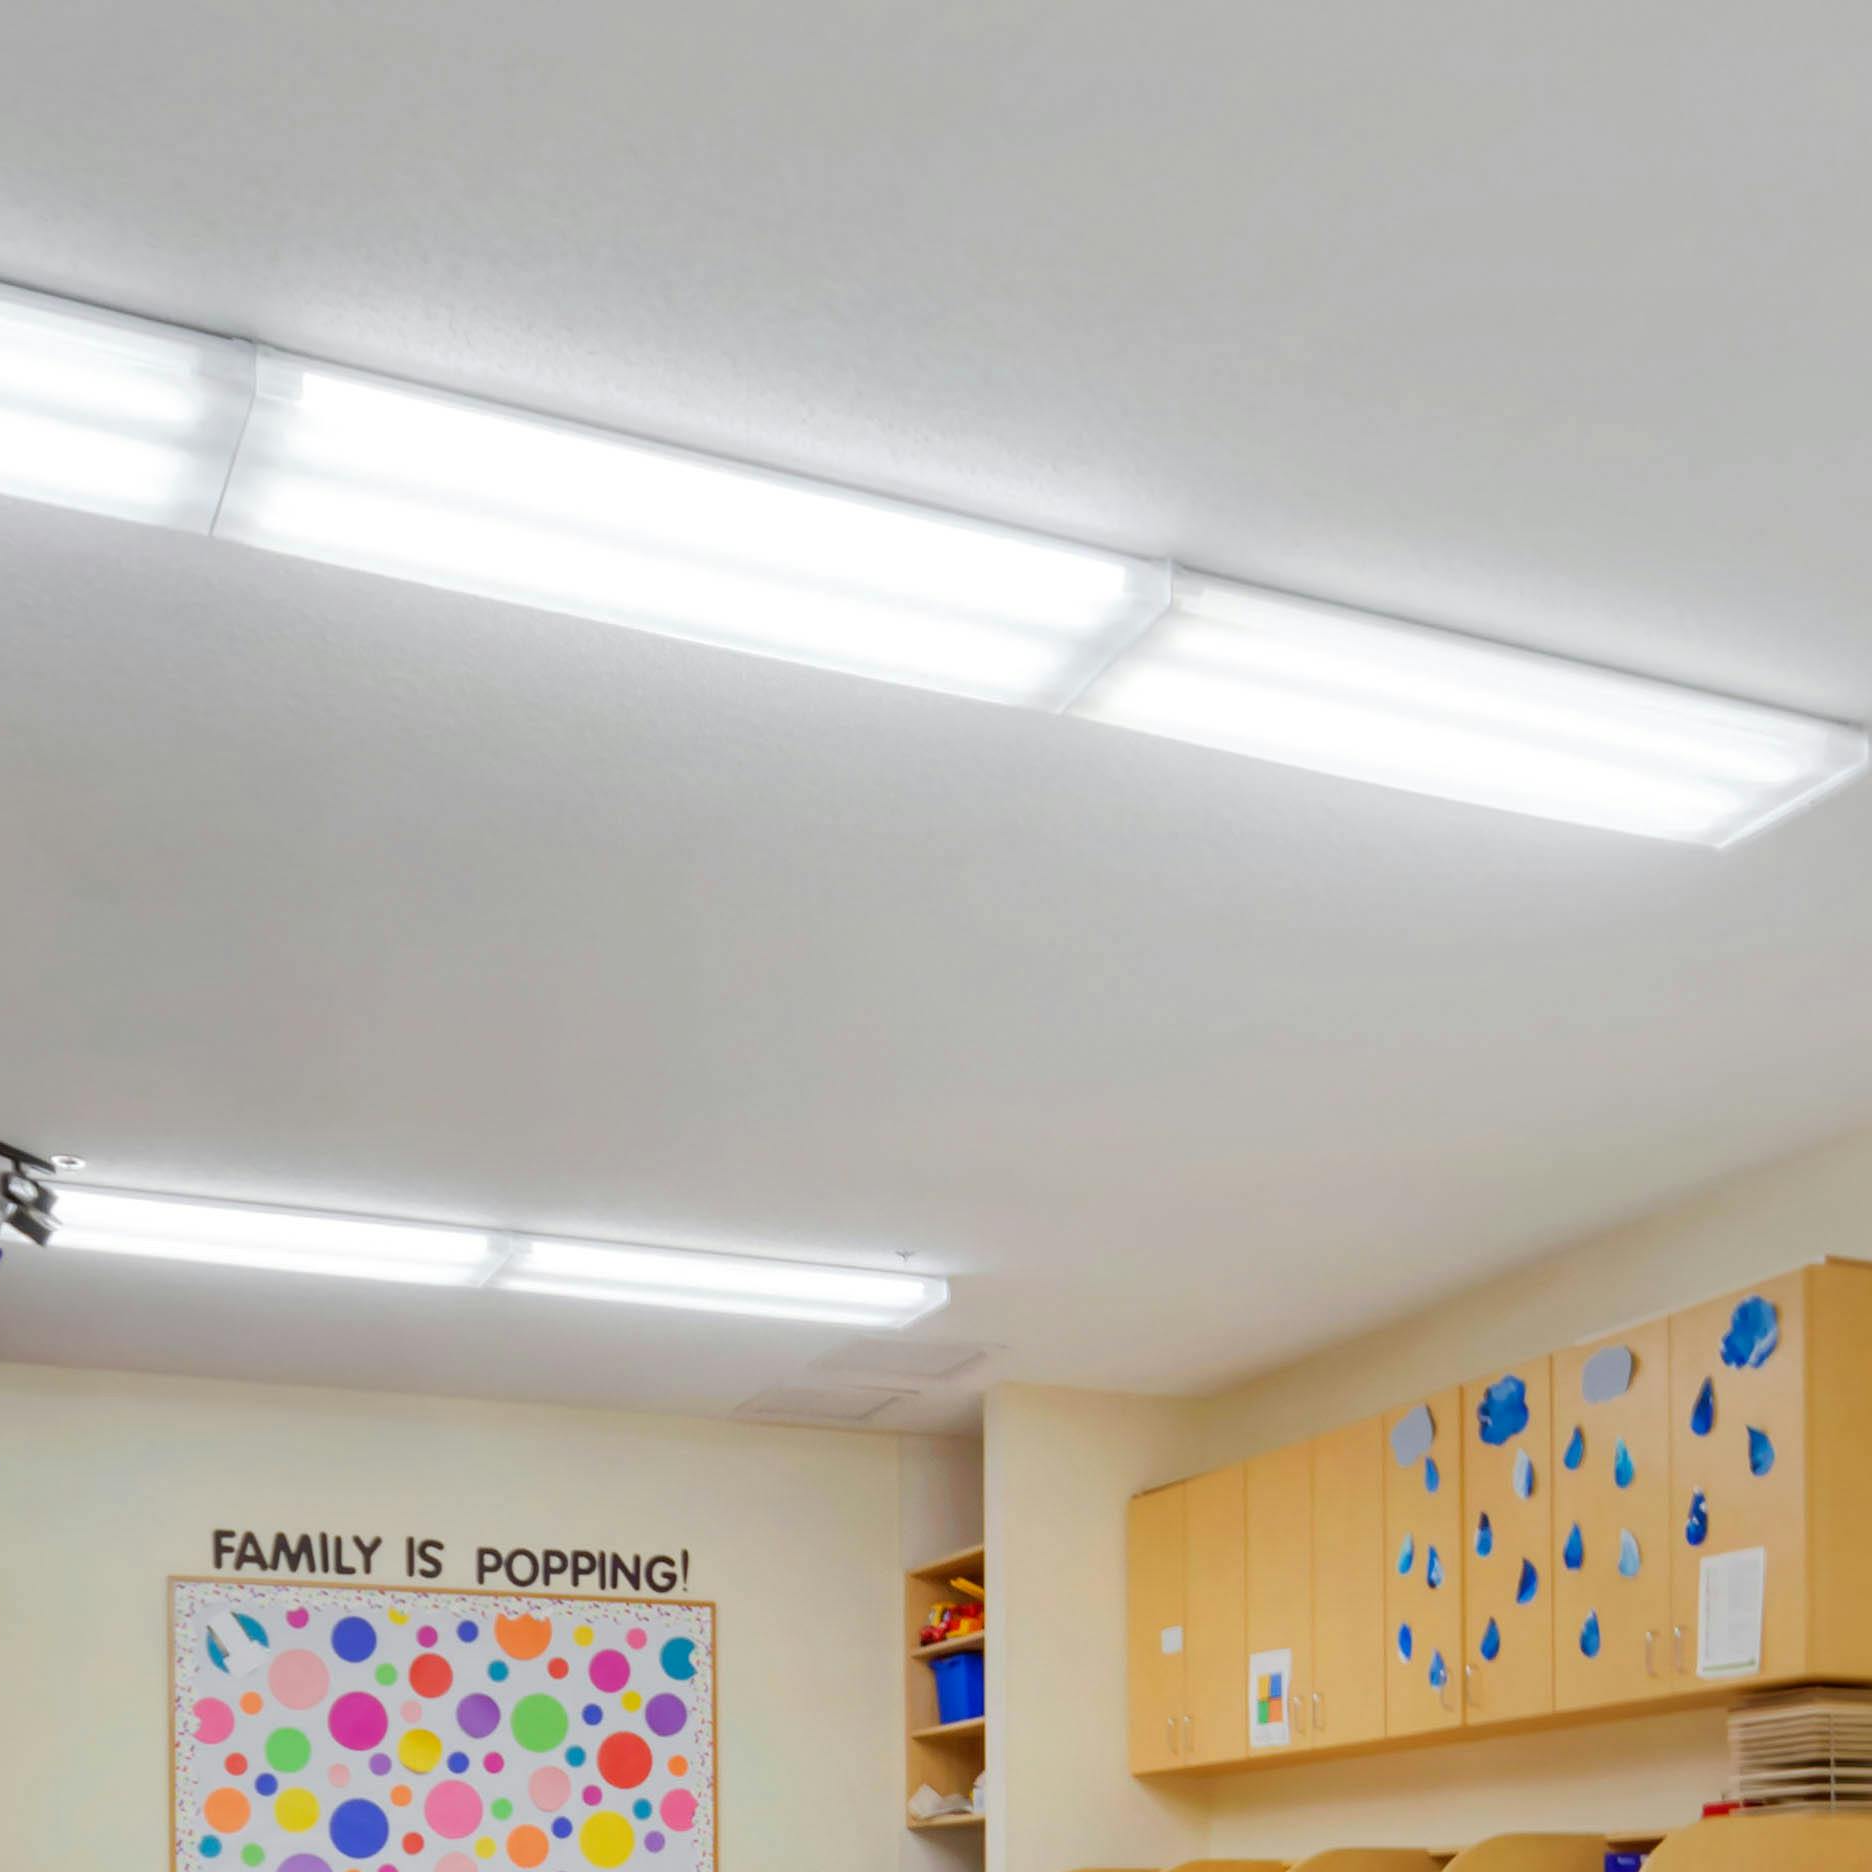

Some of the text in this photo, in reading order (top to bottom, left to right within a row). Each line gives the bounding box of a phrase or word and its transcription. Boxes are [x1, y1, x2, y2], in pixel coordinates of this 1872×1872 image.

[211, 1529, 690, 1593] FAMILY IS POPPING!
